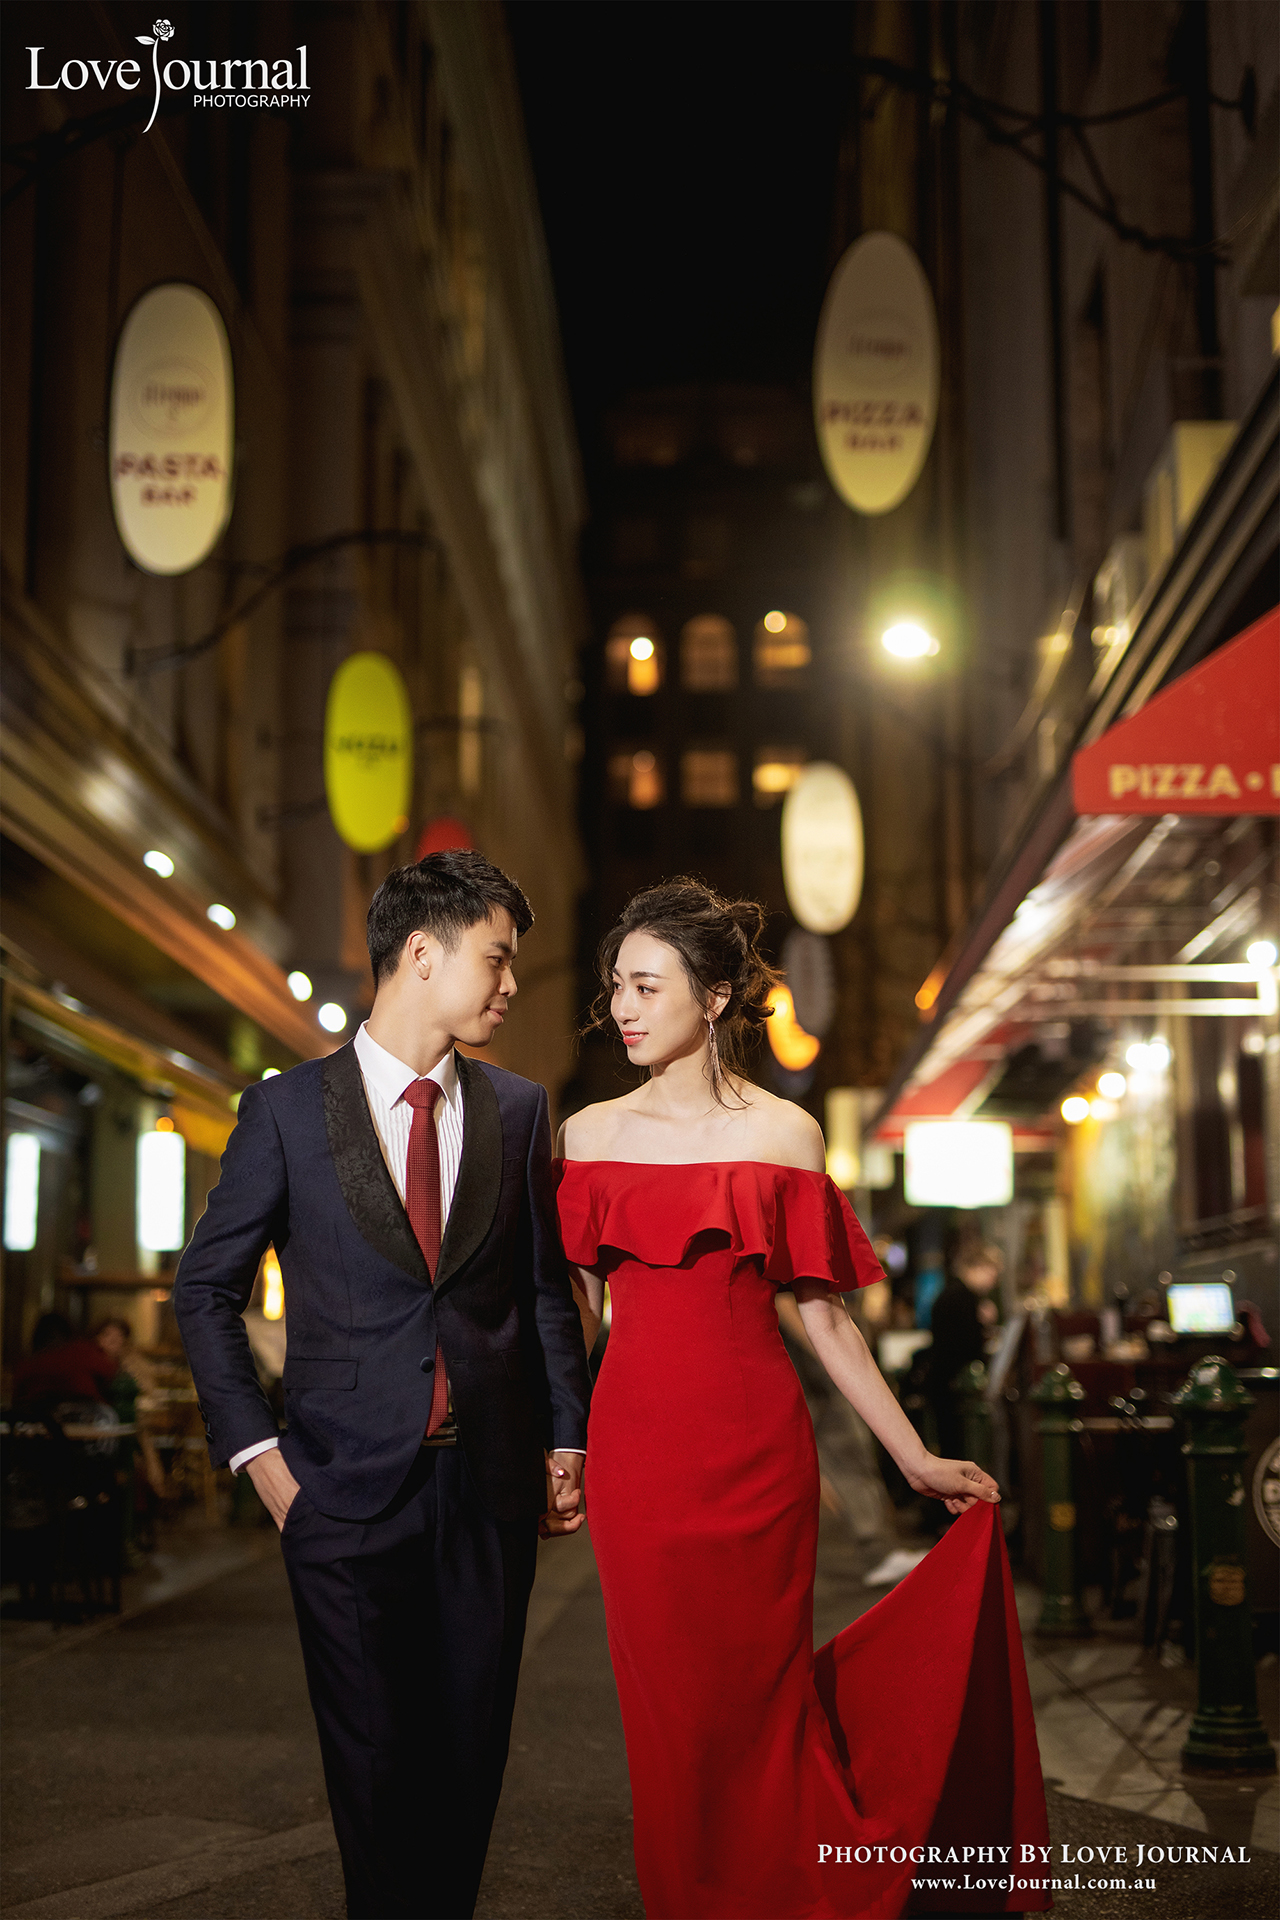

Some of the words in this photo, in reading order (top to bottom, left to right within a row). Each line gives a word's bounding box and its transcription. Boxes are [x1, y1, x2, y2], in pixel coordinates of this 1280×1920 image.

[824, 401, 923, 427] PIZZA
[115, 453, 224, 478] PASTA
[1109, 764, 1241, 799] PIZZA
